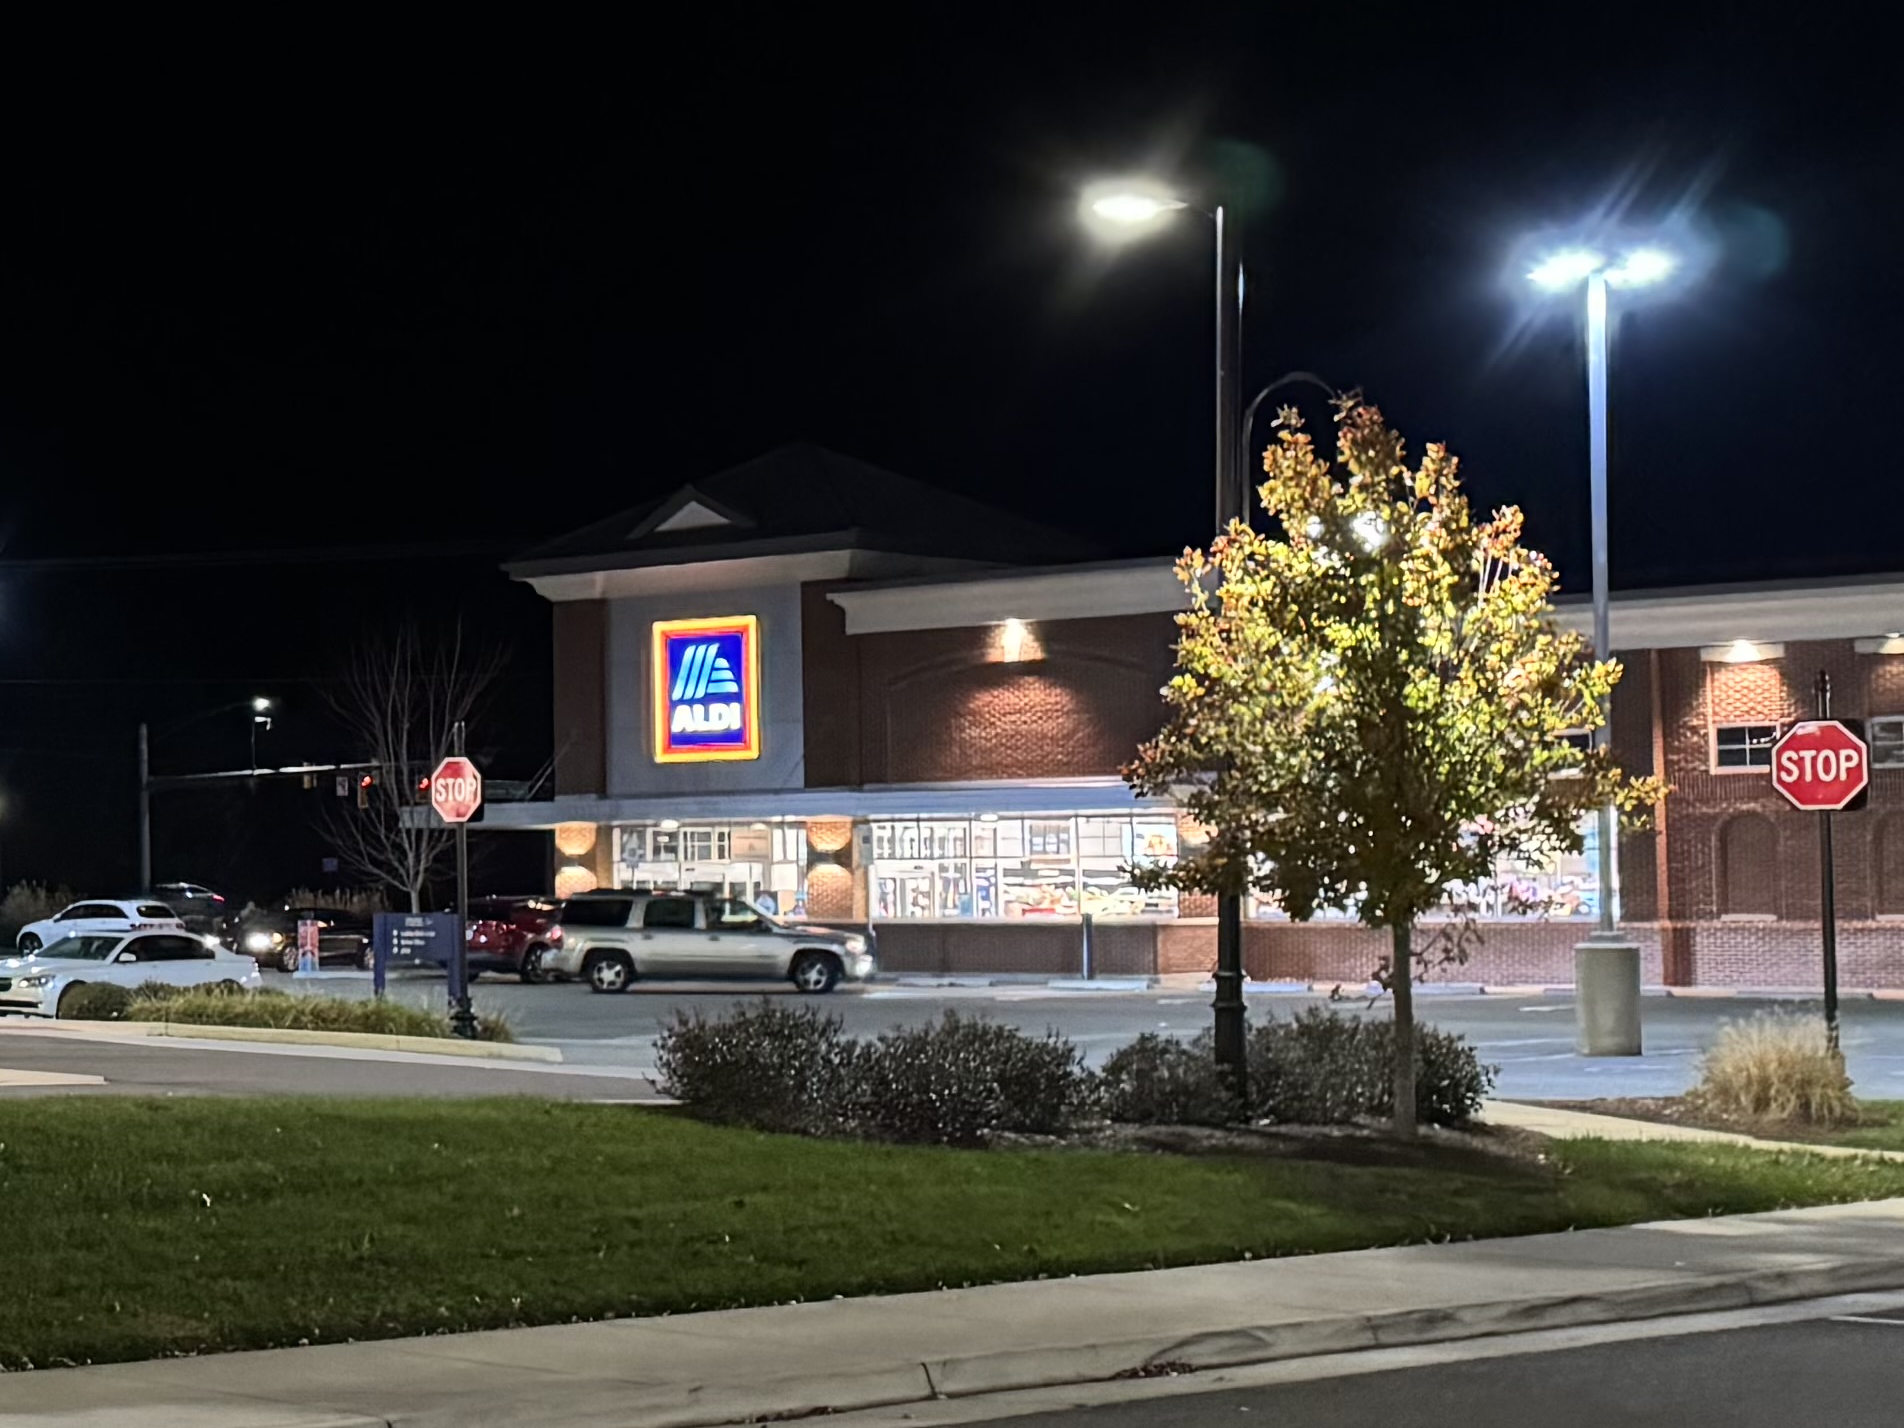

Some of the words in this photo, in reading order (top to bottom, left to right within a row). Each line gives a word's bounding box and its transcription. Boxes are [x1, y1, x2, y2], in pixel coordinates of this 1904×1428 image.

[671, 702, 741, 732] ALDI
[1779, 748, 1860, 783] STOP
[435, 777, 477, 803] STOP
